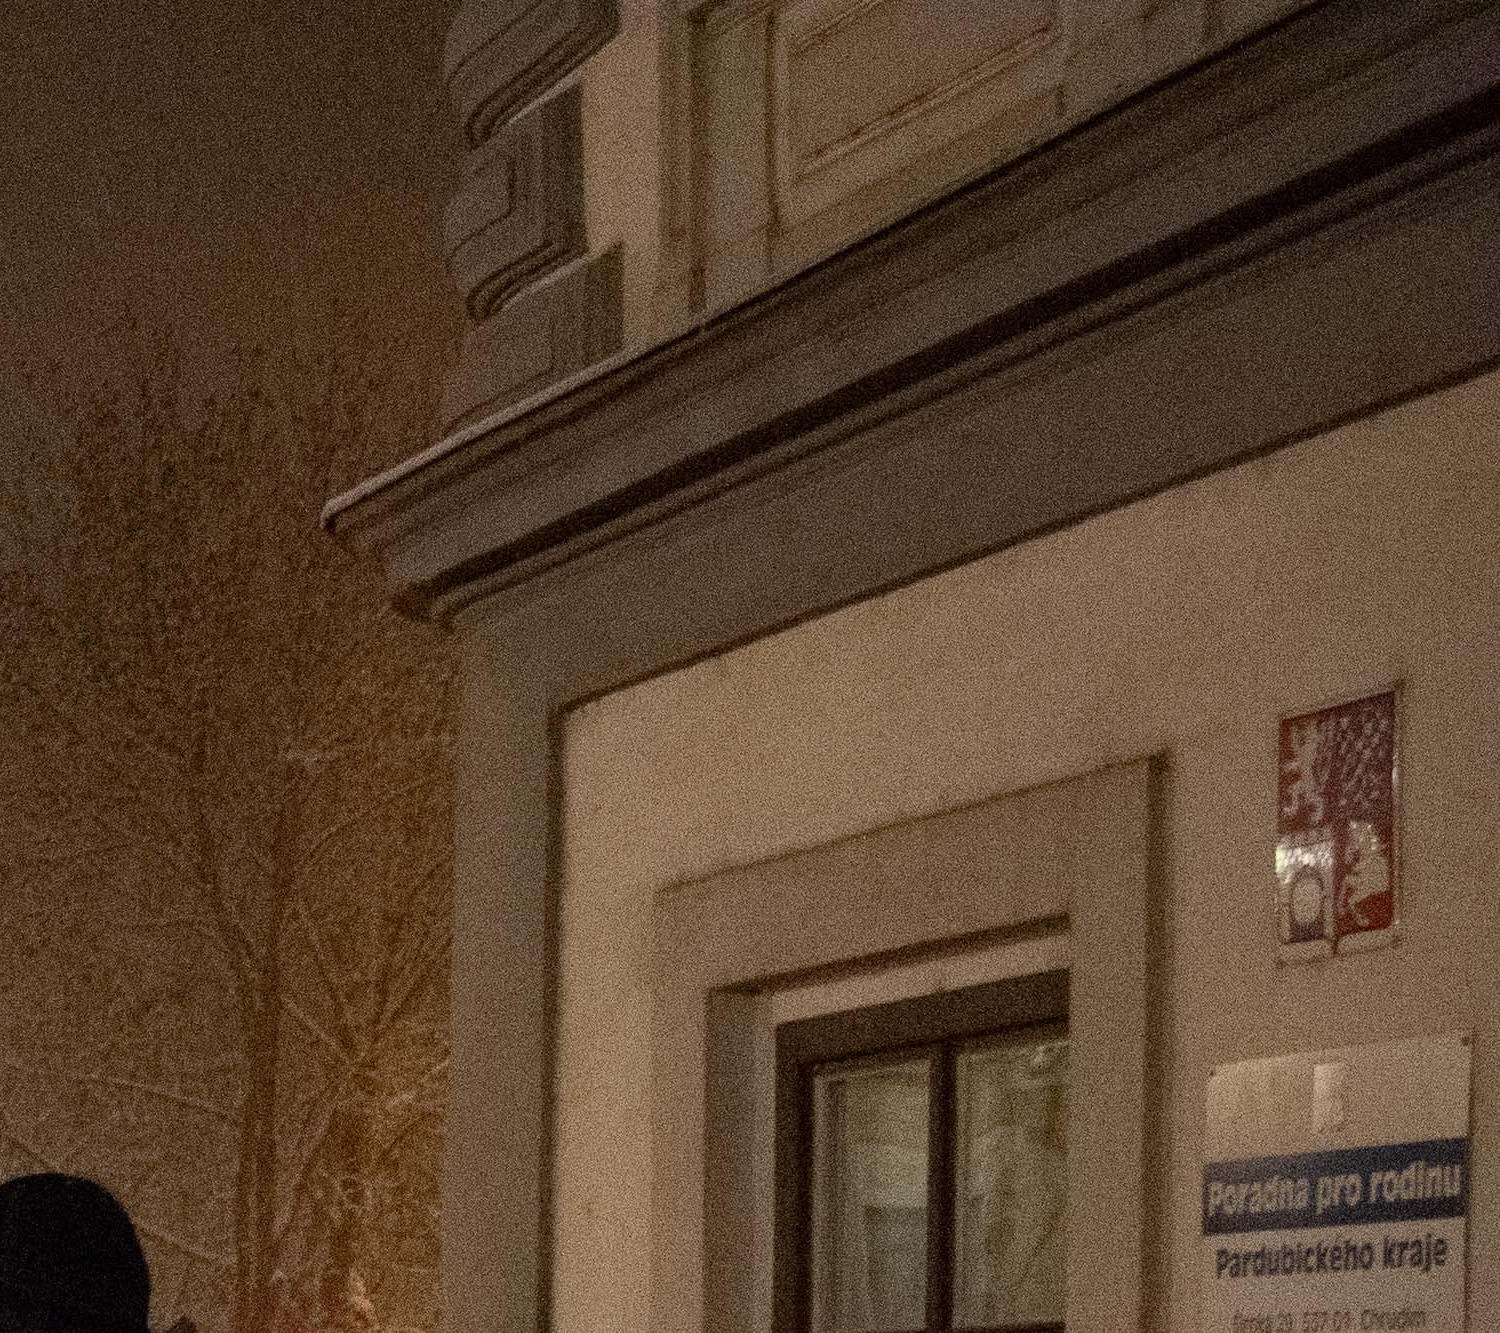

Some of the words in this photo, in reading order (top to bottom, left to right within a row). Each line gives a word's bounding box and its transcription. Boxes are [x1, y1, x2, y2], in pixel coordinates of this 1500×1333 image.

[1207, 1174, 1311, 1217] Poradna
[1314, 1173, 1363, 1216] pro
[1368, 1161, 1461, 1202] rodinu
[1216, 1235, 1374, 1279] Pardubického
[1382, 1232, 1449, 1273] kraje
